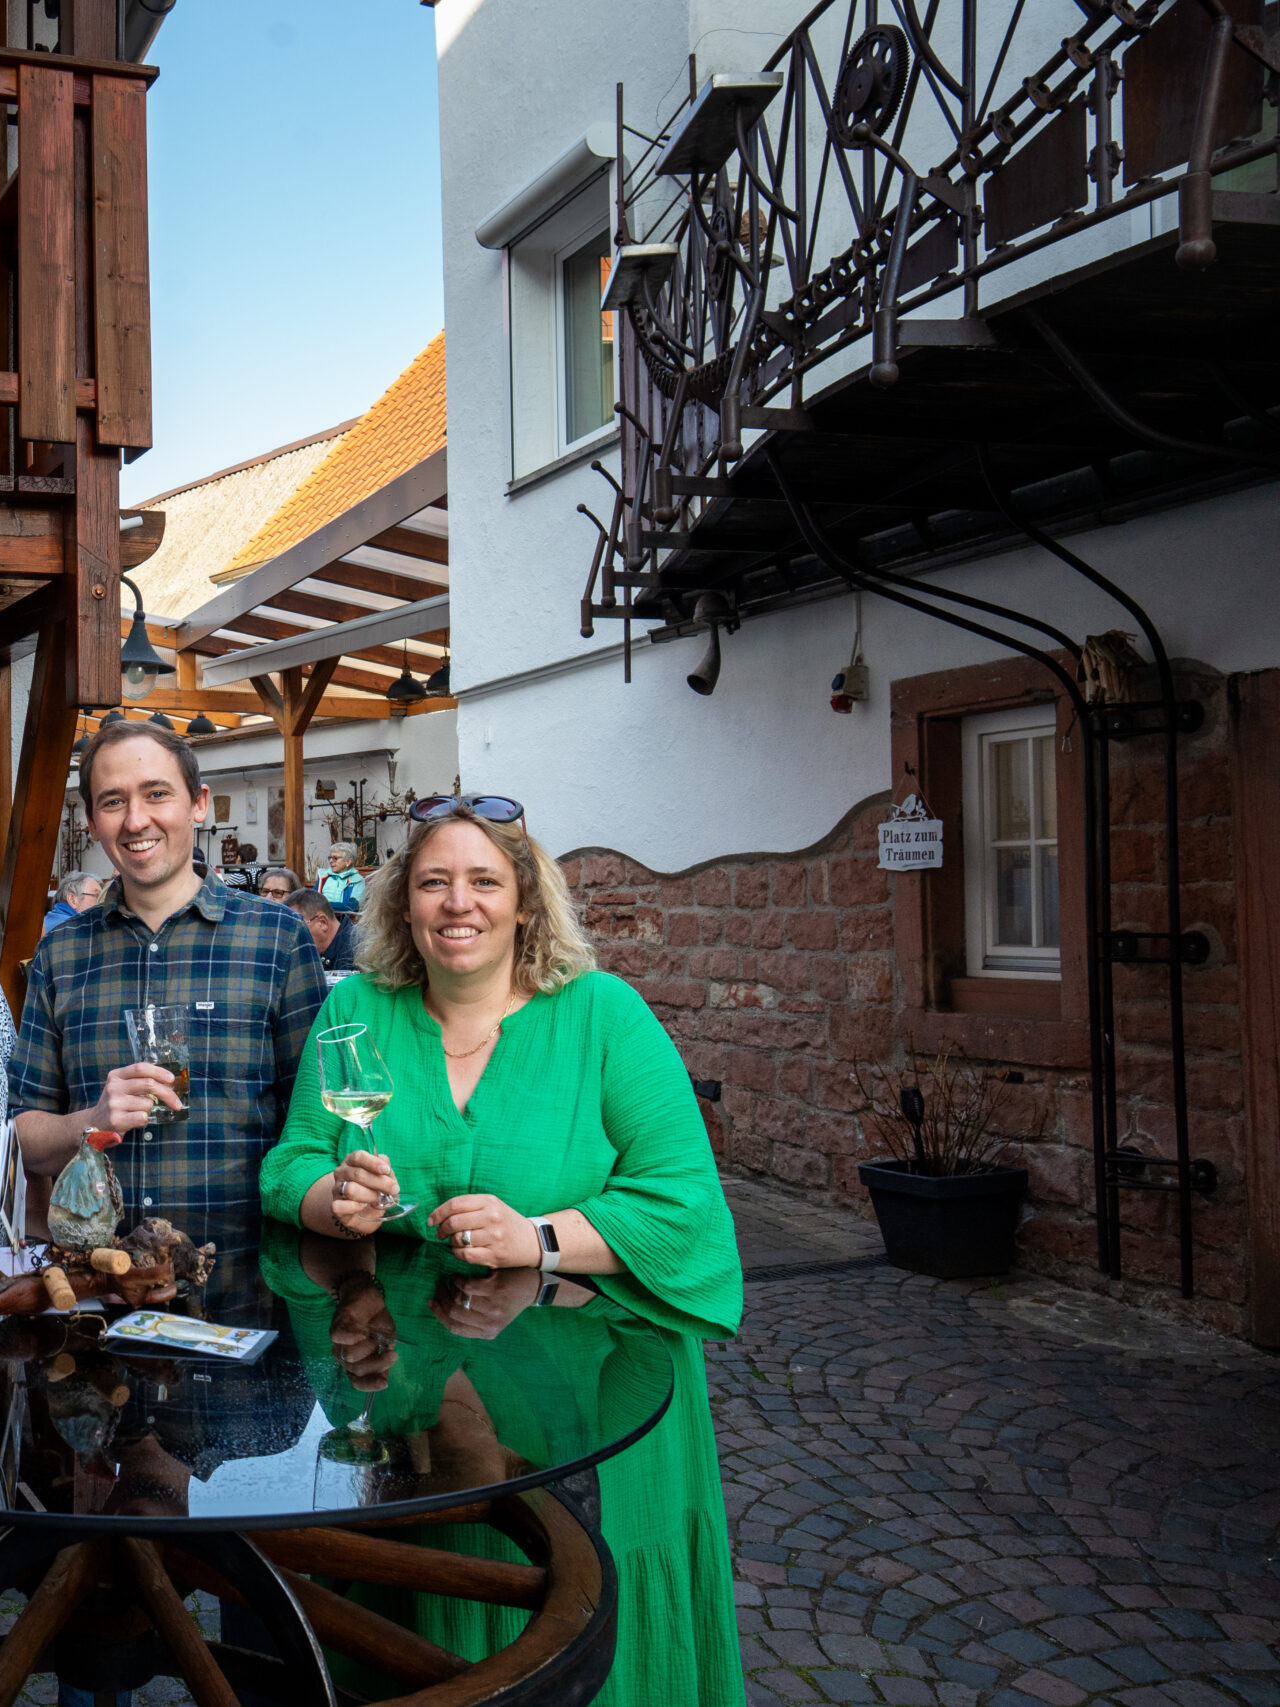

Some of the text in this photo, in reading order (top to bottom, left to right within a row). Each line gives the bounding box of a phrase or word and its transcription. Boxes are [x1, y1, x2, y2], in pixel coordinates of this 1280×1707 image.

[883, 830, 937, 843] Platz zum
[885, 848, 935, 861] Träumen
